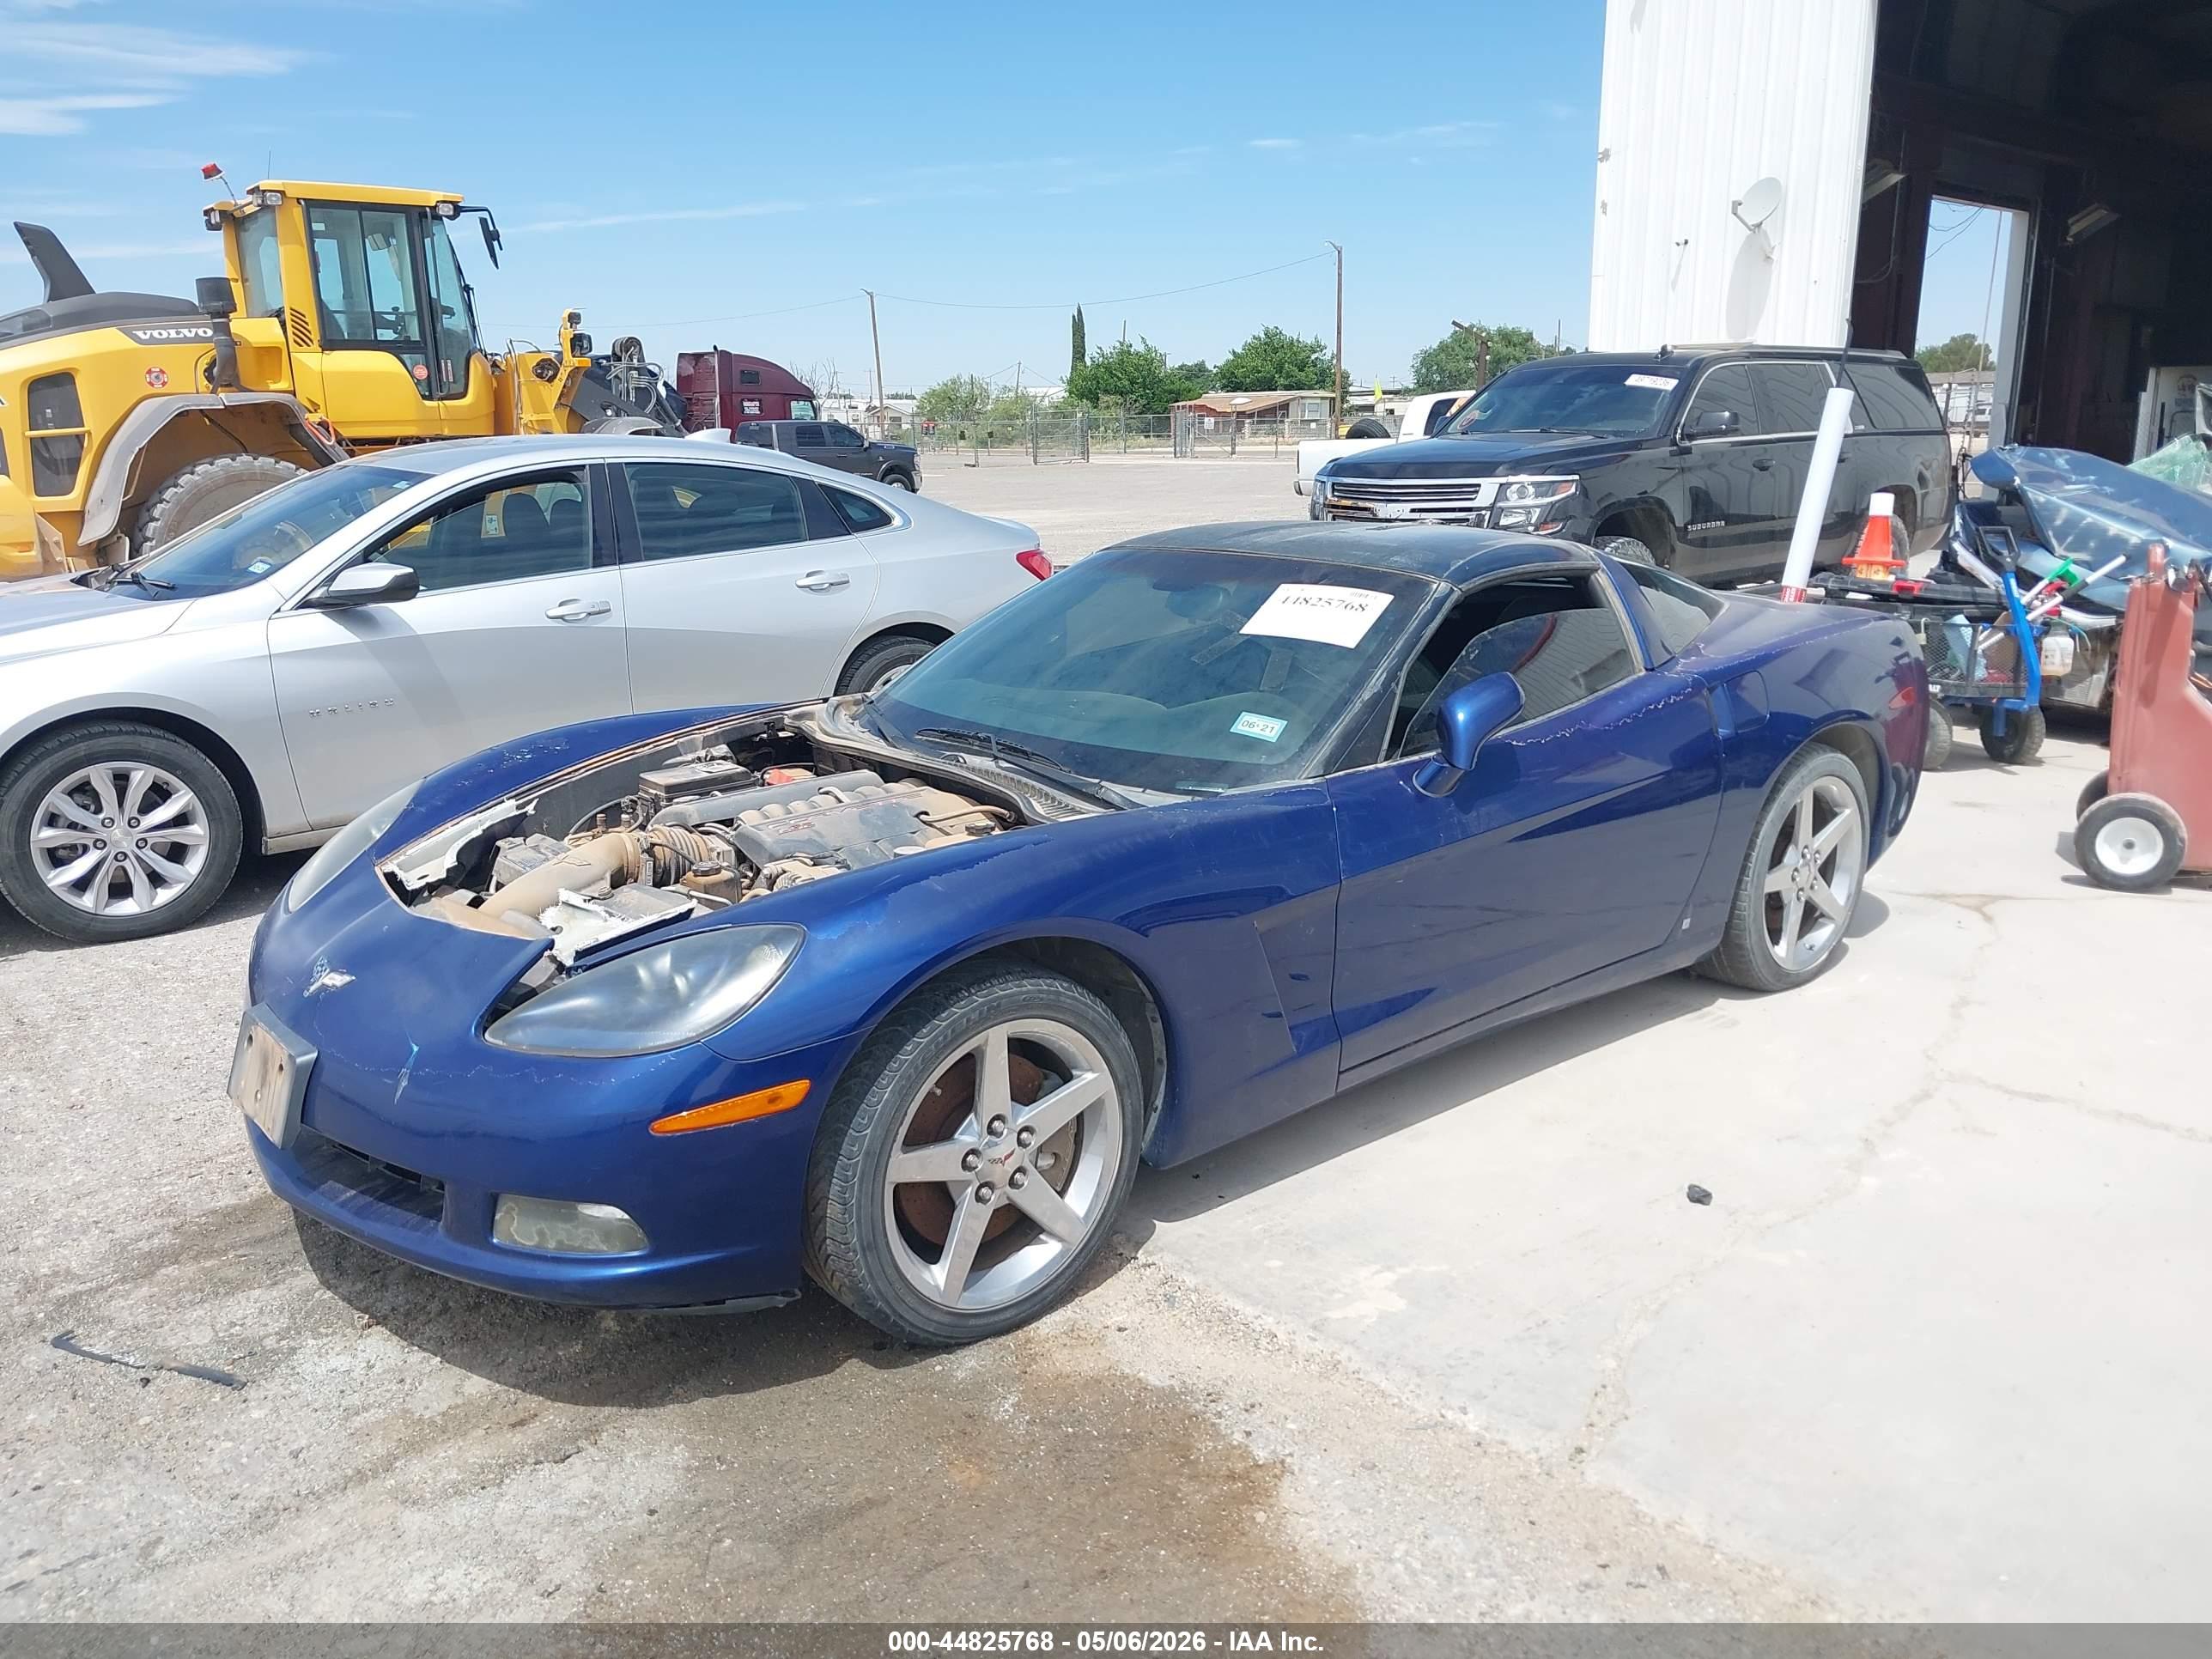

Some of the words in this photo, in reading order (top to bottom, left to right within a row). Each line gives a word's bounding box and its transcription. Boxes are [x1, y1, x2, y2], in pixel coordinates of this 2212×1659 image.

[132, 327, 214, 340] VOLVO
[1687, 520, 1725, 532] SUBURBAN
[309, 697, 394, 717] MALIBU
